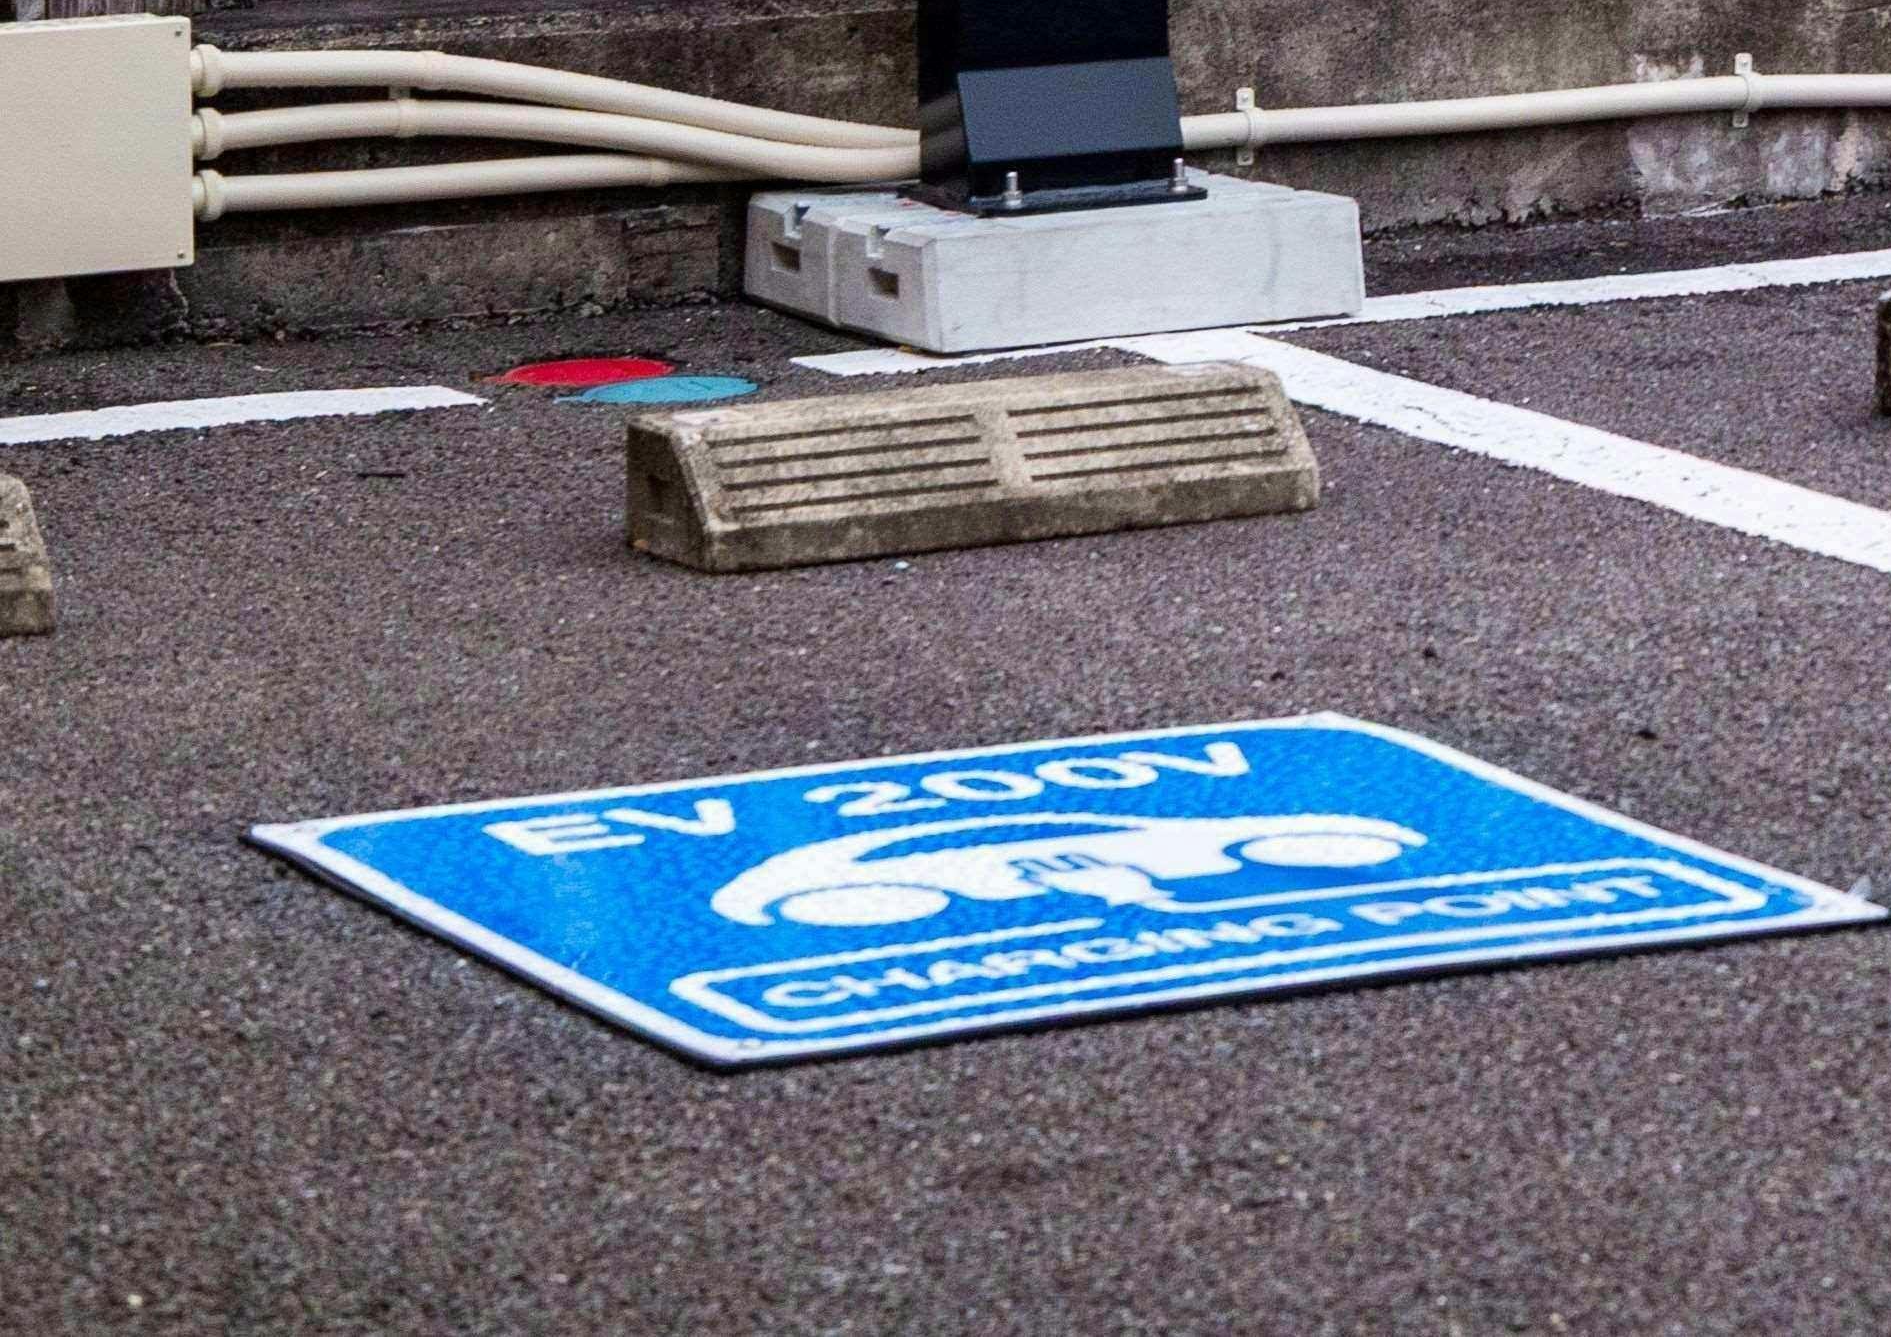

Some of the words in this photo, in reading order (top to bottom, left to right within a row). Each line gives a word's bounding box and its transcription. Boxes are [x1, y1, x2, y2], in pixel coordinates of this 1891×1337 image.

[483, 798, 736, 856] EV
[803, 741, 1250, 817] 200V
[763, 913, 1342, 1009] CHARGING
[1350, 874, 1663, 926] POINT
